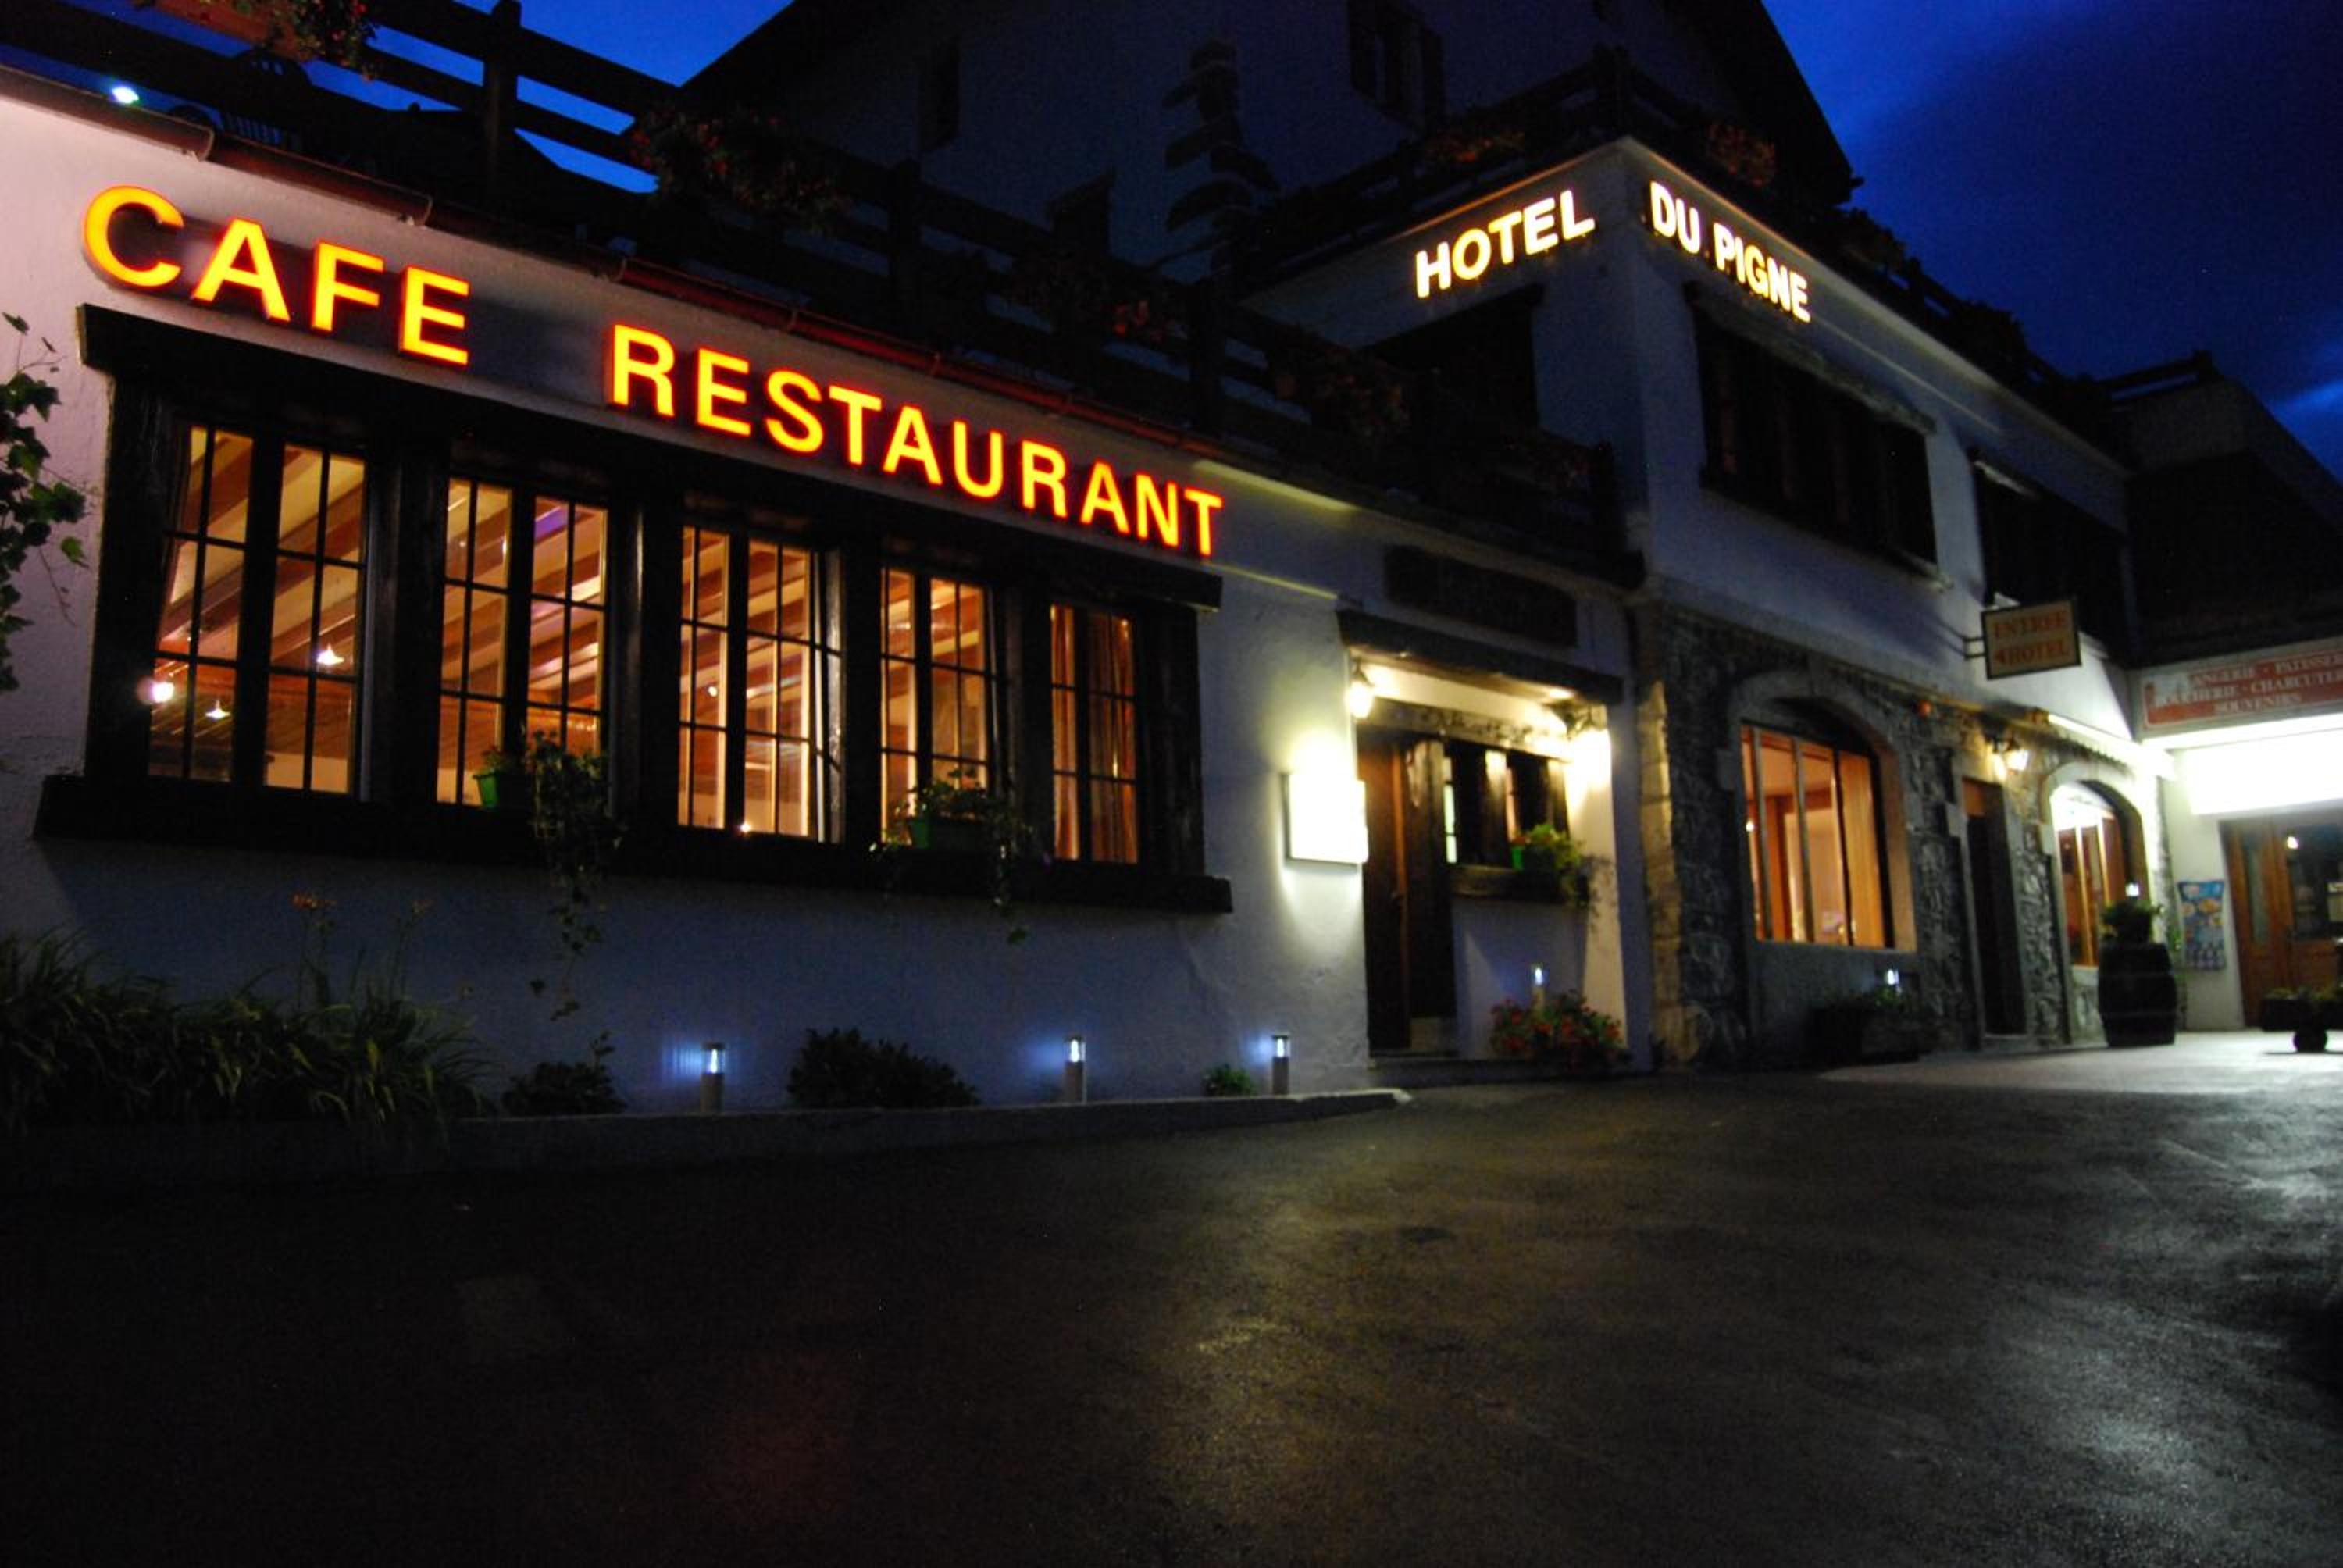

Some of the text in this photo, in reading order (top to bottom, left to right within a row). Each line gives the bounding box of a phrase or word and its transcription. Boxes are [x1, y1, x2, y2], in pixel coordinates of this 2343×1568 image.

[1414, 189, 1596, 299] HOTEL
[1649, 180, 1810, 323] DU PIGNE
[83, 184, 1223, 557] CAFE RESTAURANT
